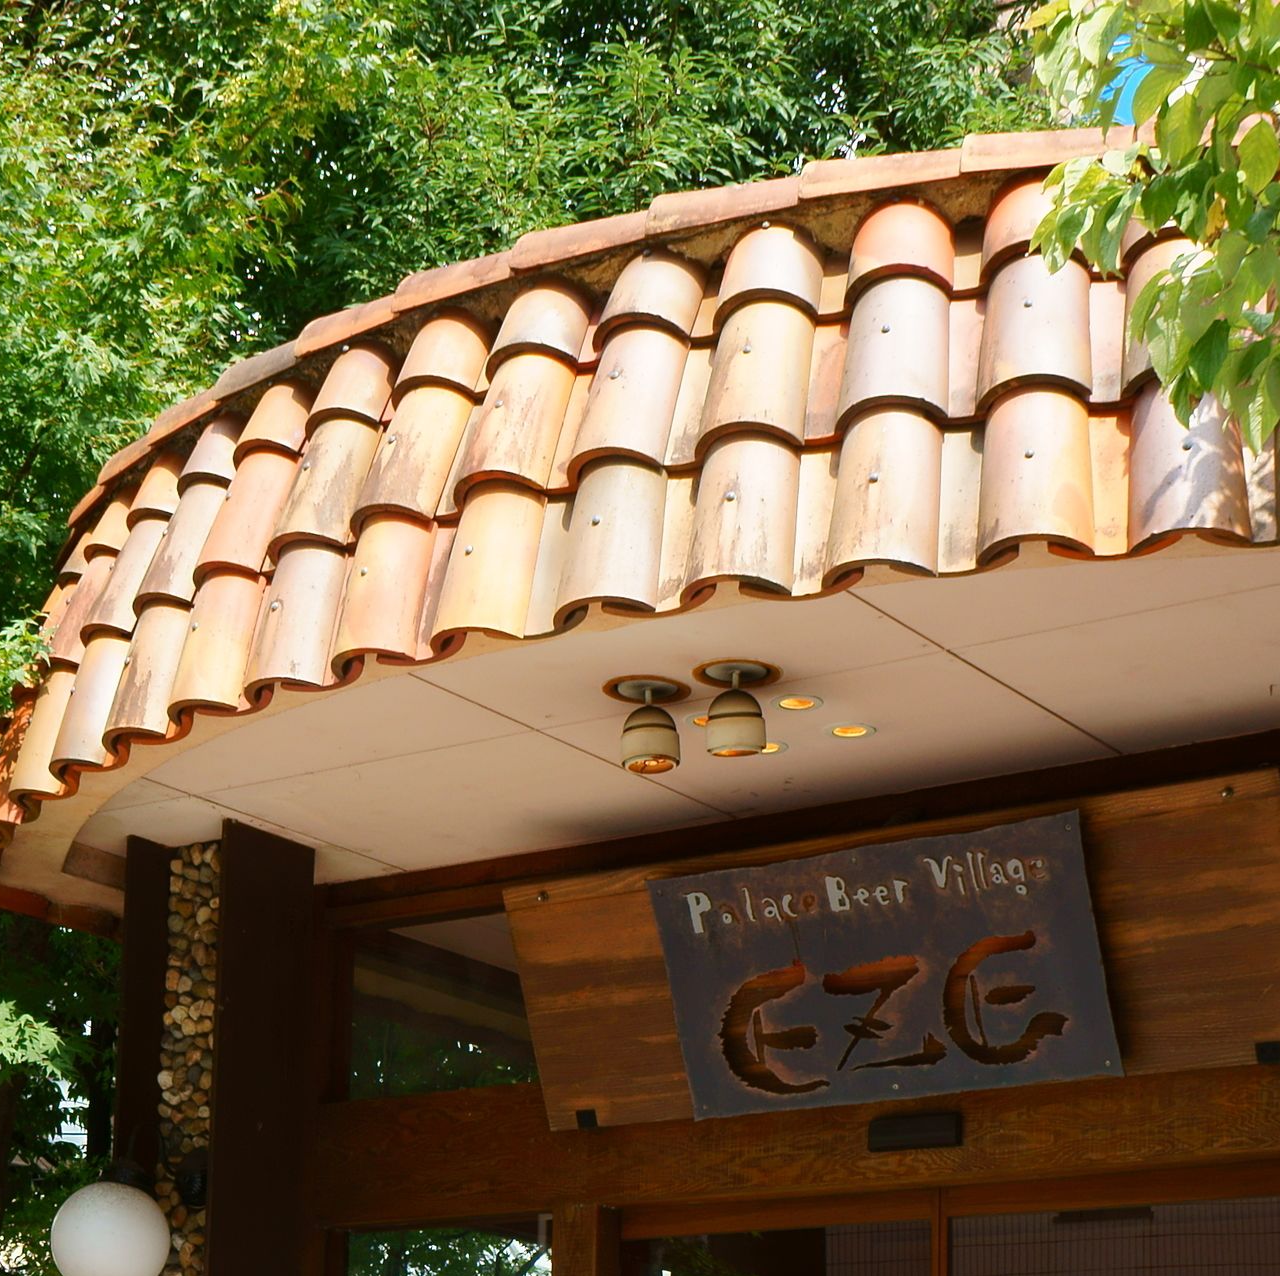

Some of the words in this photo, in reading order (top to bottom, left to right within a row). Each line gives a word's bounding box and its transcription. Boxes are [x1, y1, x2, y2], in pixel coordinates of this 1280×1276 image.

[824, 876, 908, 912] Beer
[923, 851, 1046, 896] Village
[720, 930, 1070, 1095] EZE
